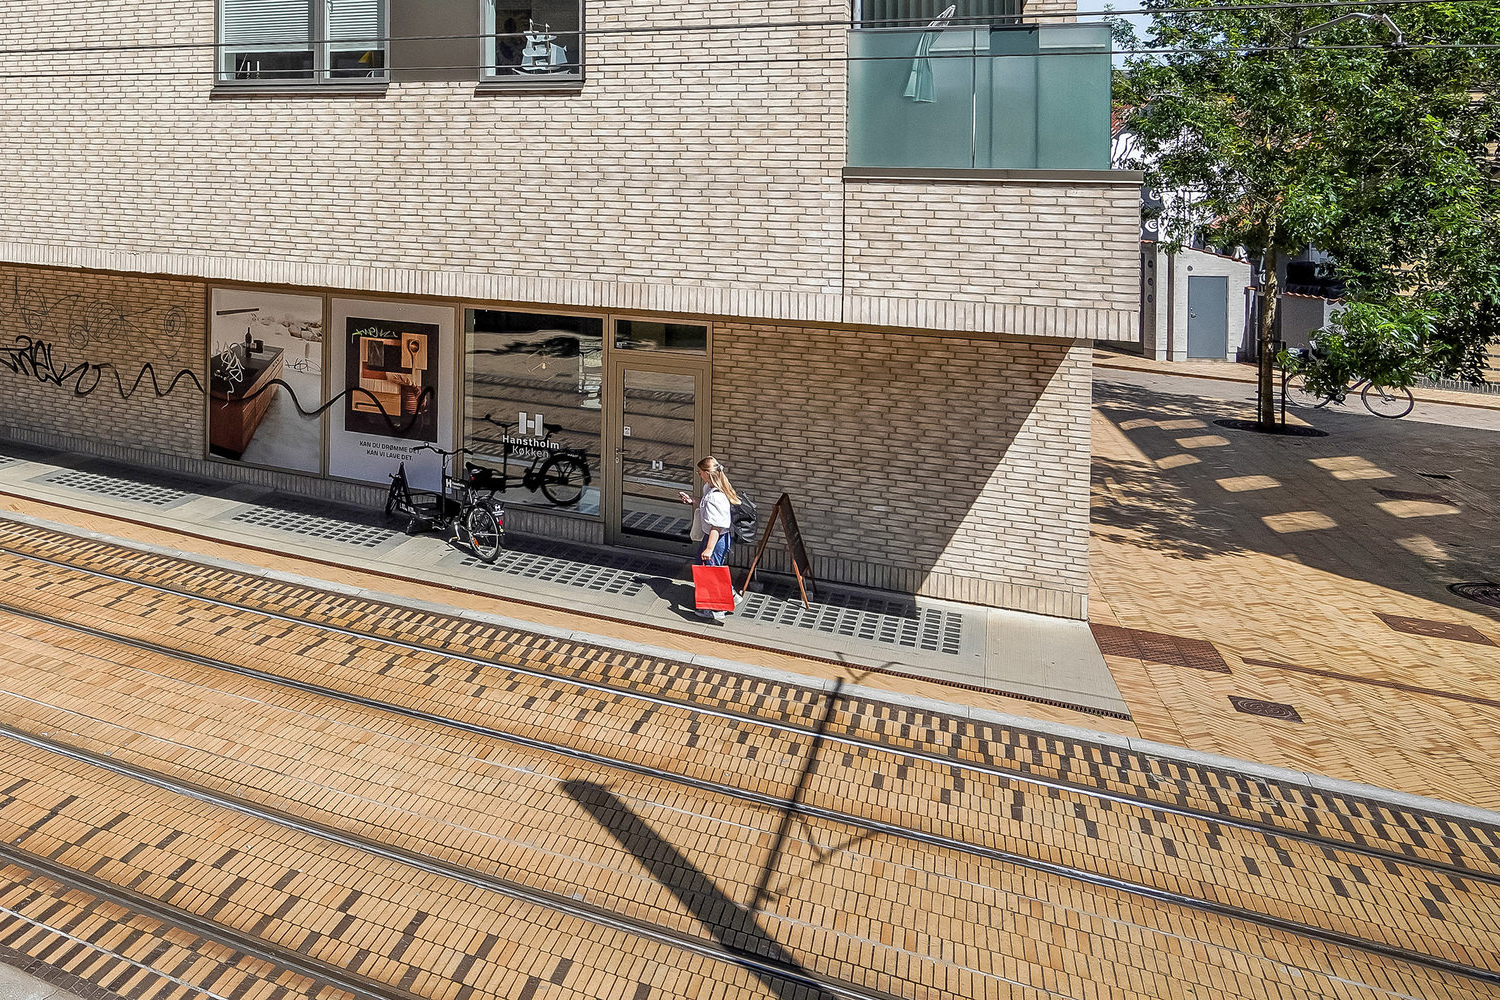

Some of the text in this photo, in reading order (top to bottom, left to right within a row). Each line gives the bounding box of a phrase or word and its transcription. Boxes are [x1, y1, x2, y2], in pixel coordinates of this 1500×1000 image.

[381, 444, 407, 452] DRØMME
[502, 434, 560, 449] Hanstholm
[512, 445, 549, 458] Køkken
